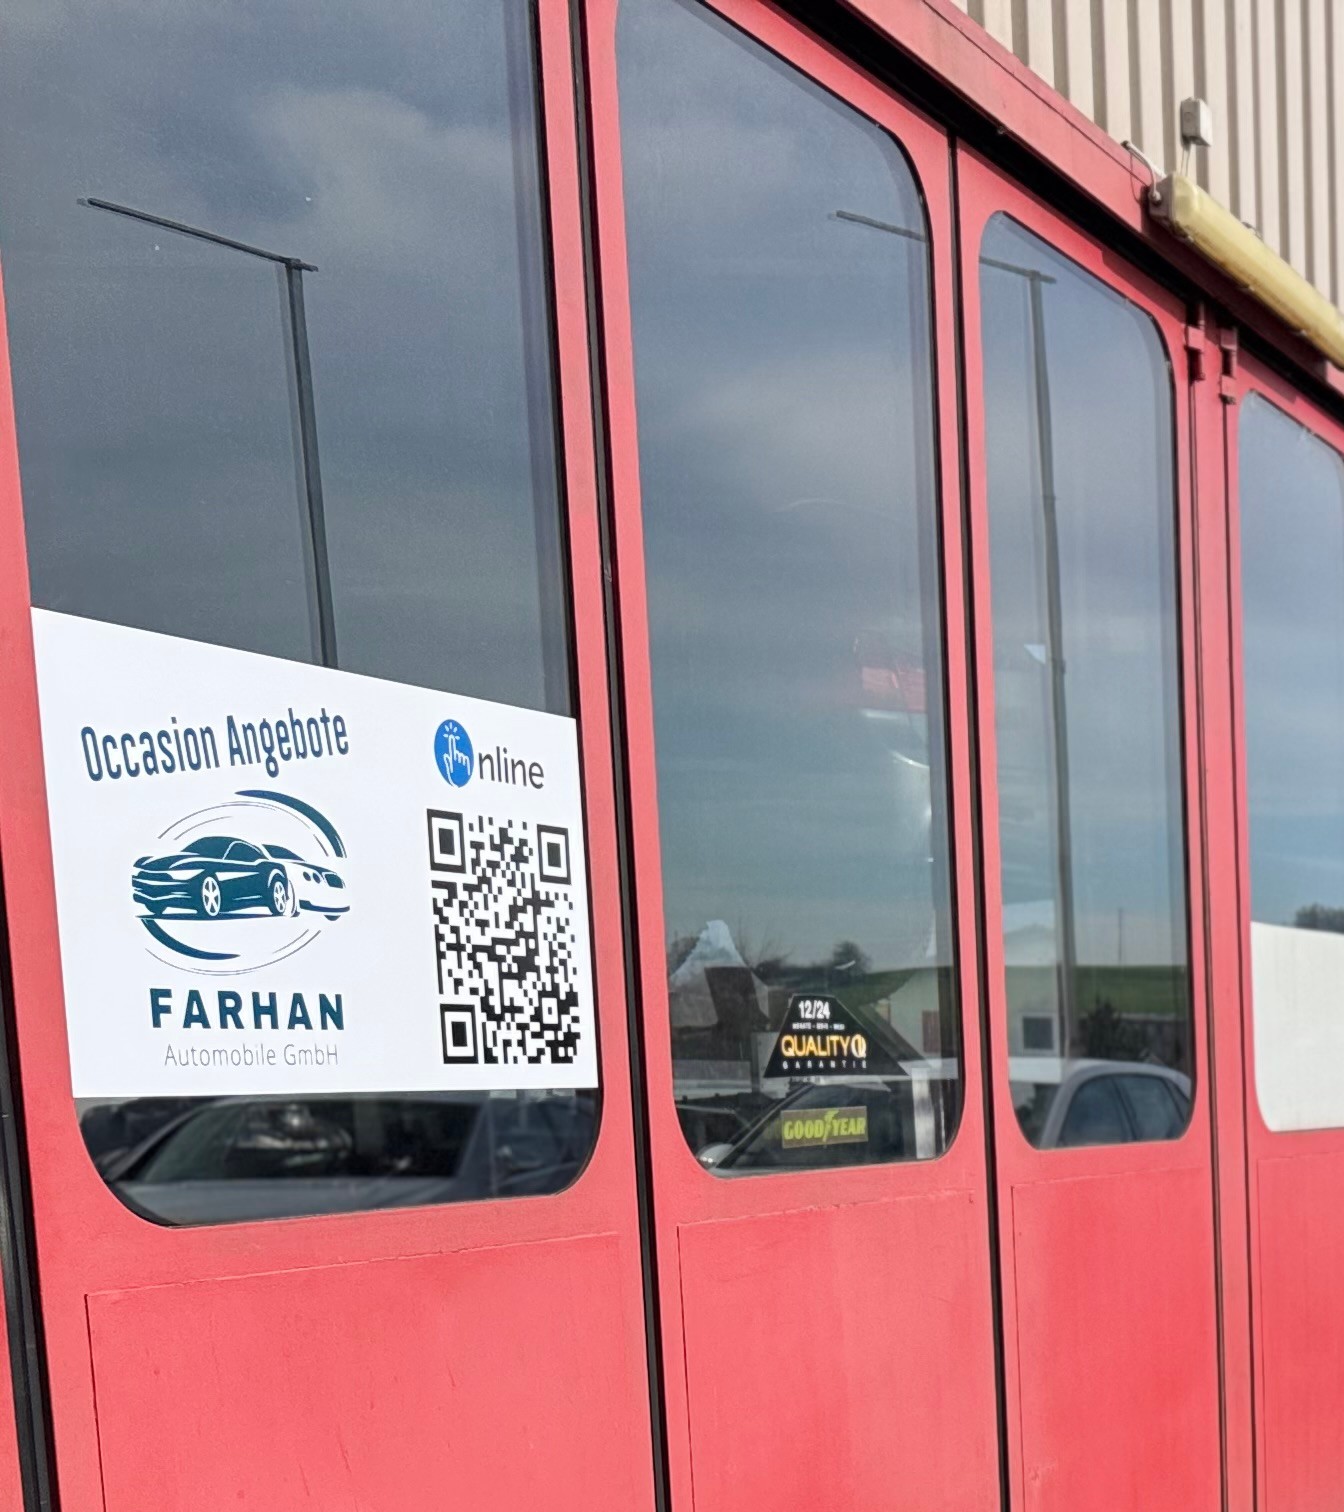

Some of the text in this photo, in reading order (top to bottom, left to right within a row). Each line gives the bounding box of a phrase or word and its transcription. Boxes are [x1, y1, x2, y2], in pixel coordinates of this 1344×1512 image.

[81, 707, 350, 782] Occasion Angebote
[150, 987, 345, 1031] FARHAN
[799, 1000, 830, 1019] 12/24
[164, 1042, 339, 1067] Automobile GmbH
